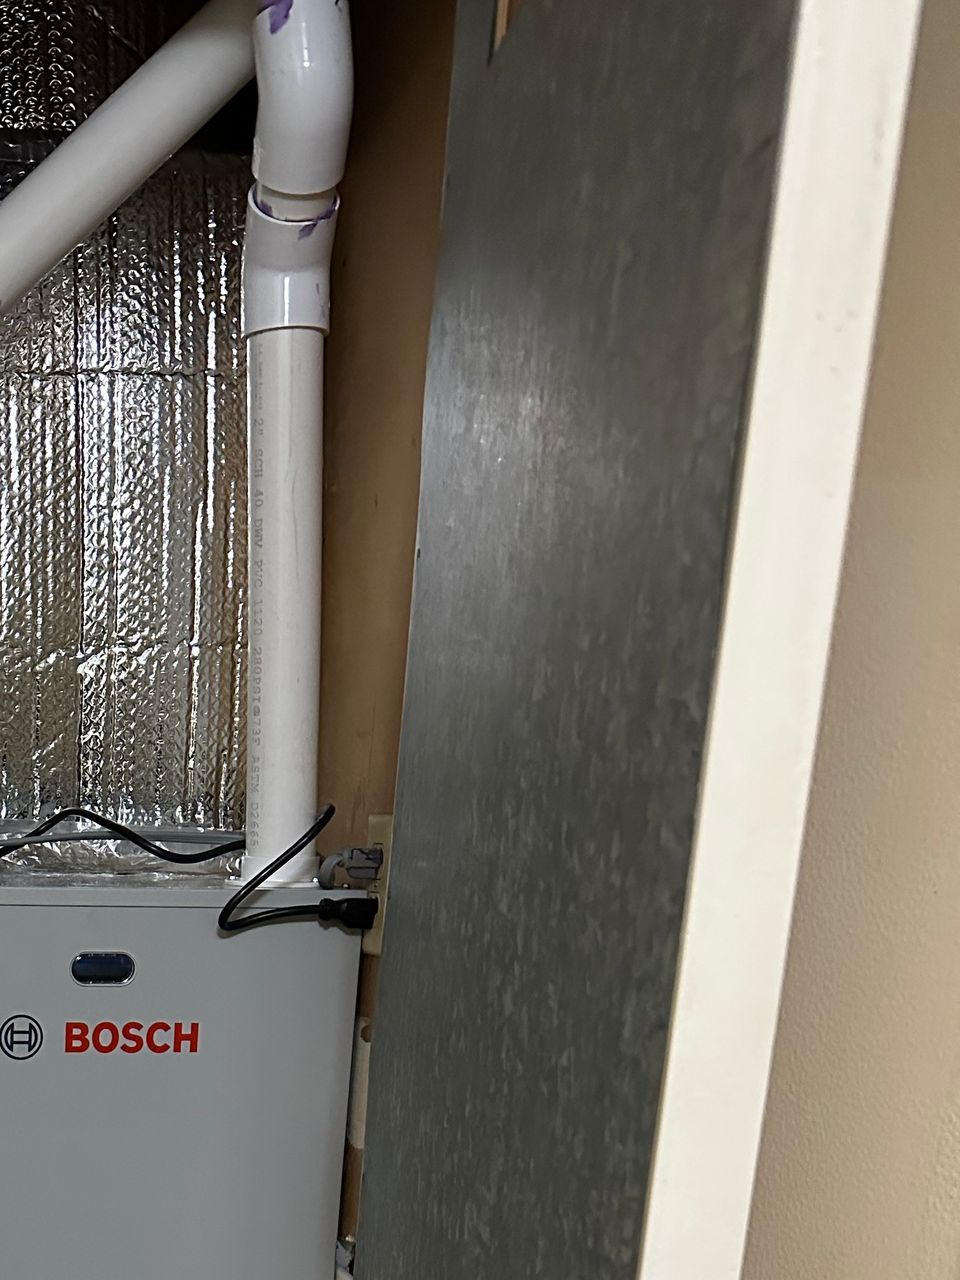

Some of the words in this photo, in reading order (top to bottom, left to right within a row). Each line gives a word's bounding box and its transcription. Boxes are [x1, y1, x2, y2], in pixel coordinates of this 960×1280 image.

[254, 448, 264, 479] SCH
[254, 489, 264, 508] 40
[253, 518, 263, 549] DWV
[253, 559, 263, 589] PVC
[253, 599, 263, 637] 1120
[250, 754, 260, 794] ASTM
[64, 1021, 200, 1054] BOSCH
